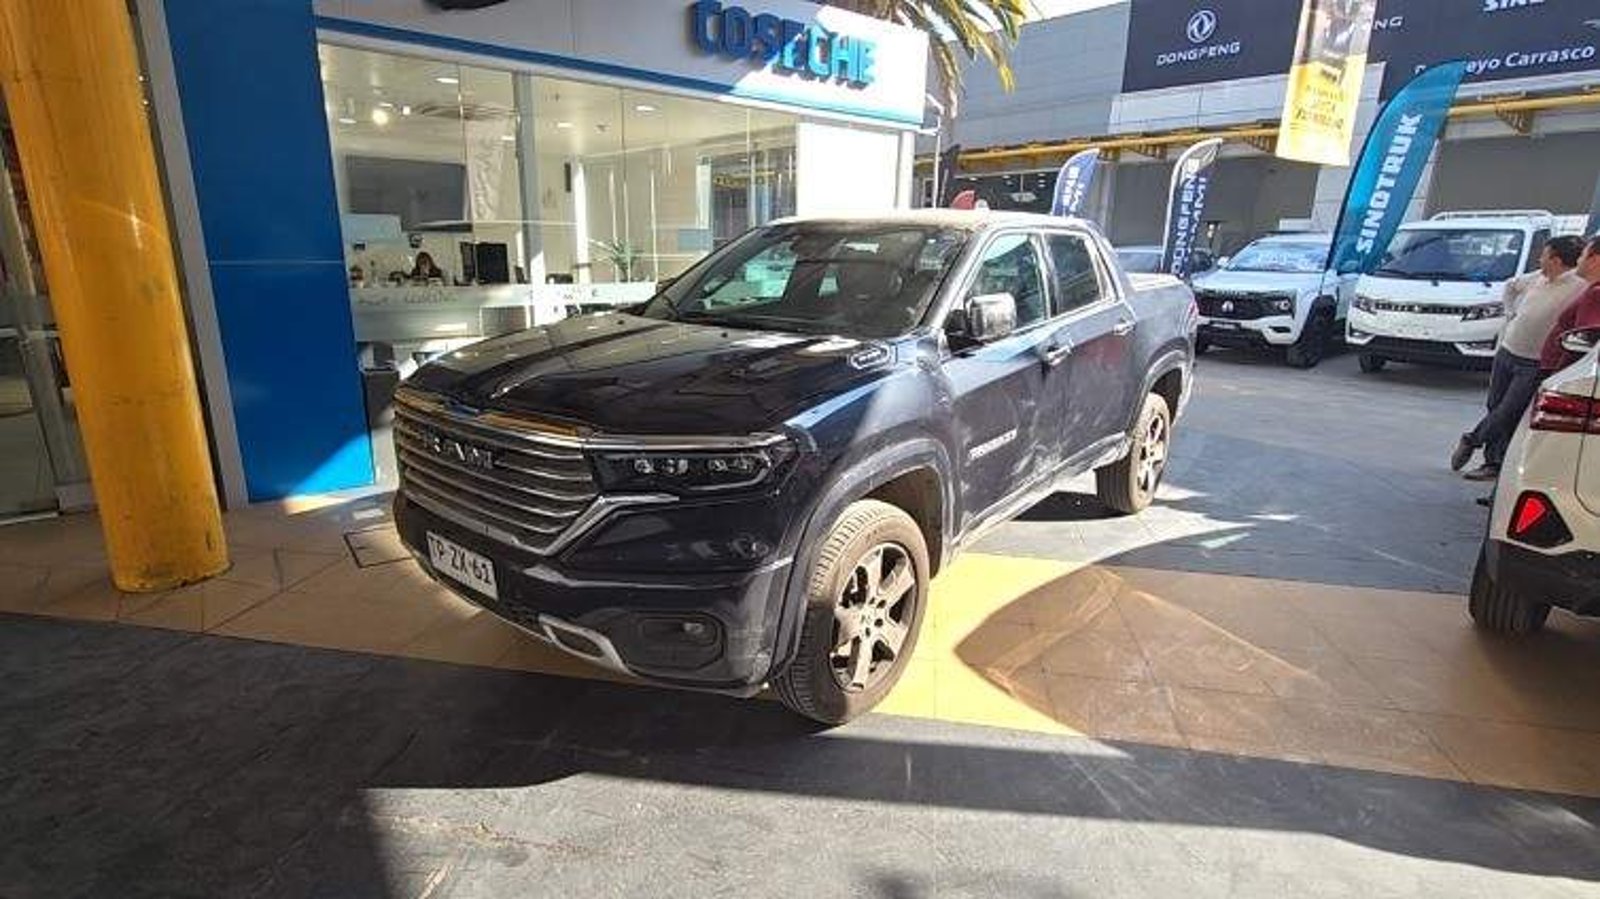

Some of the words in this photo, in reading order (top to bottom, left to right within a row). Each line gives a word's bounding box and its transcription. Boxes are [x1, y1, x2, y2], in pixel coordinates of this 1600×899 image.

[692, 0, 876, 83] COSECHE
[1156, 41, 1240, 66] DONGFENG
[1505, 46, 1595, 67] Carrasco
[1356, 113, 1424, 255] SINOTRUK
